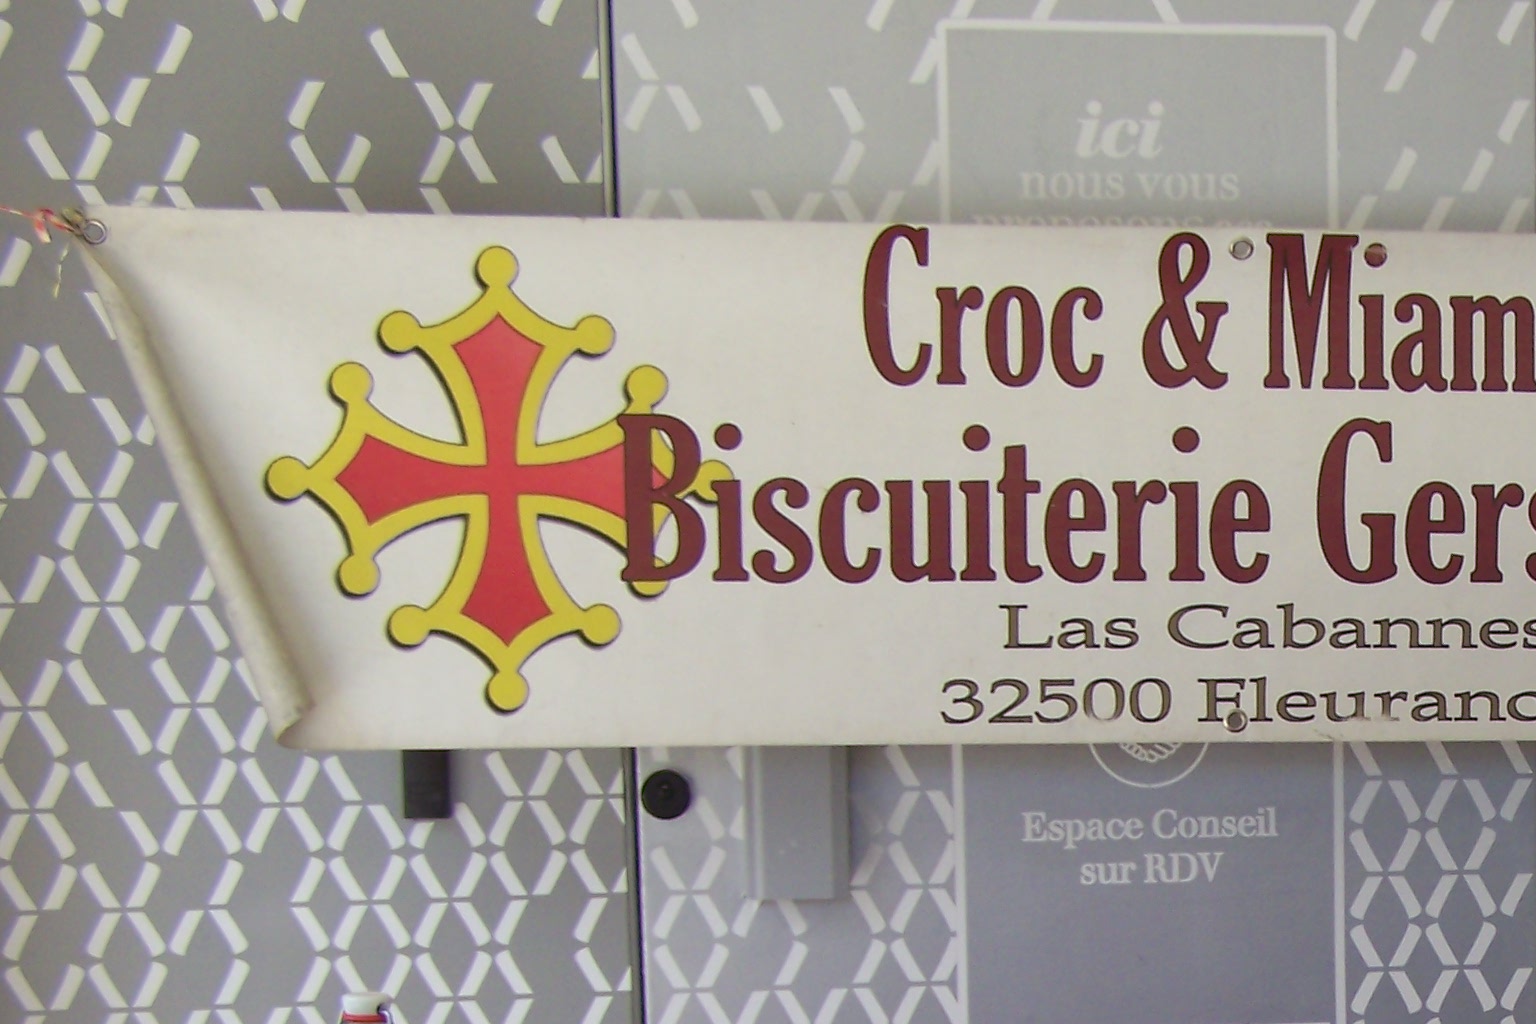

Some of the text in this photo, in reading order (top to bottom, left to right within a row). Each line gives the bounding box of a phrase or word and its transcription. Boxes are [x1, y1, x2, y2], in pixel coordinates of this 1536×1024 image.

[1076, 100, 1165, 159] ici
[1020, 171, 1241, 200] nous vous
[862, 224, 1105, 388] Croc
[1142, 230, 1231, 391] &
[617, 413, 1271, 584] Biscuiterie
[999, 603, 1140, 649] Las
[940, 678, 1172, 723] 32500
[1021, 806, 1279, 849] Espace Conseil
[1080, 852, 1225, 885] sur RDV
